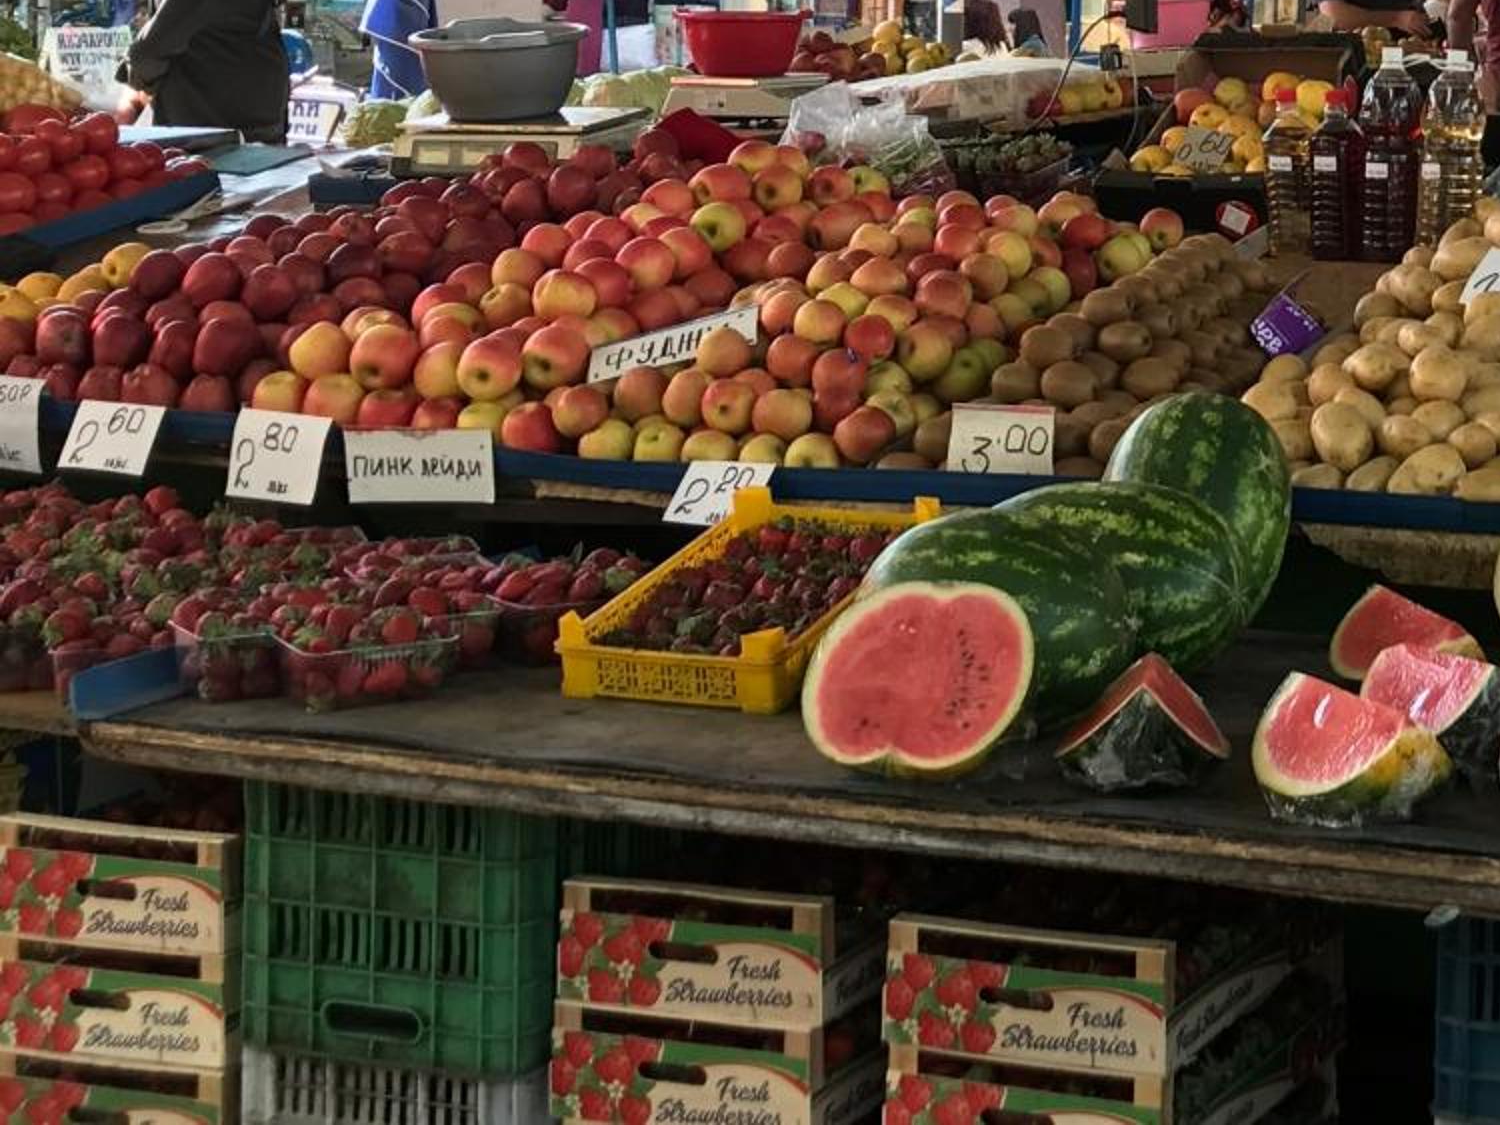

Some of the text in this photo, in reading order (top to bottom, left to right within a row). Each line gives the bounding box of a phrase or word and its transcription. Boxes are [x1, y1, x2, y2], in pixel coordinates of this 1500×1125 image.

[107, 406, 147, 435] 60
[262, 421, 300, 453] 80
[353, 455, 414, 478] ПИНК
[140, 887, 191, 913] Fresh
[86, 909, 200, 941] Strawberries
[727, 954, 783, 983] Fresh
[665, 977, 794, 1010] Strawberries
[139, 1002, 191, 1027] Fresh
[1065, 1001, 1127, 1030] Fresh
[83, 1023, 201, 1053] Strawberries
[1001, 1022, 1139, 1058] Strawberries
[715, 1075, 771, 1103] Fresh
